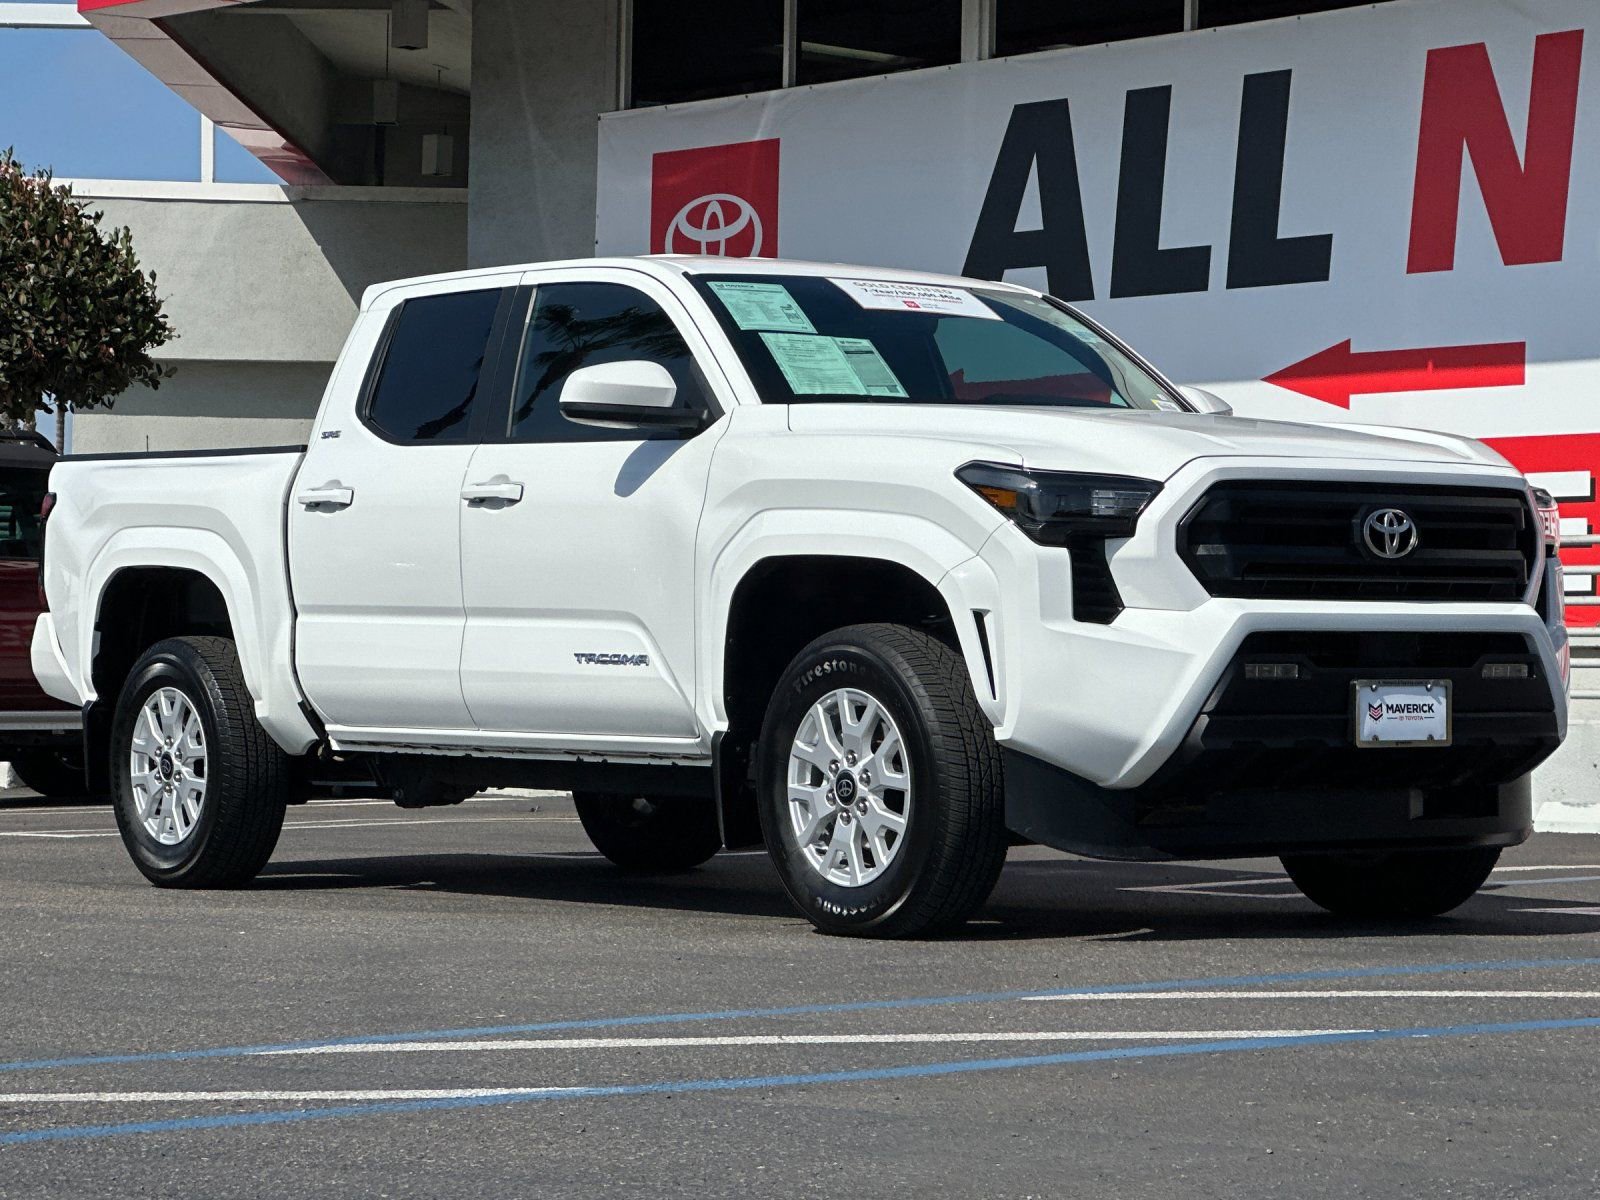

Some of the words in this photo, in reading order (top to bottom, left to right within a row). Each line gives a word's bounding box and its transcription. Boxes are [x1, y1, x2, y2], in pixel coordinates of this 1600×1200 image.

[962, 68, 1333, 302] ALL
[1407, 29, 1584, 274] N
[573, 652, 650, 667] TACOMA
[792, 659, 868, 693] Firestone
[1386, 703, 1435, 714] MAVERICK
